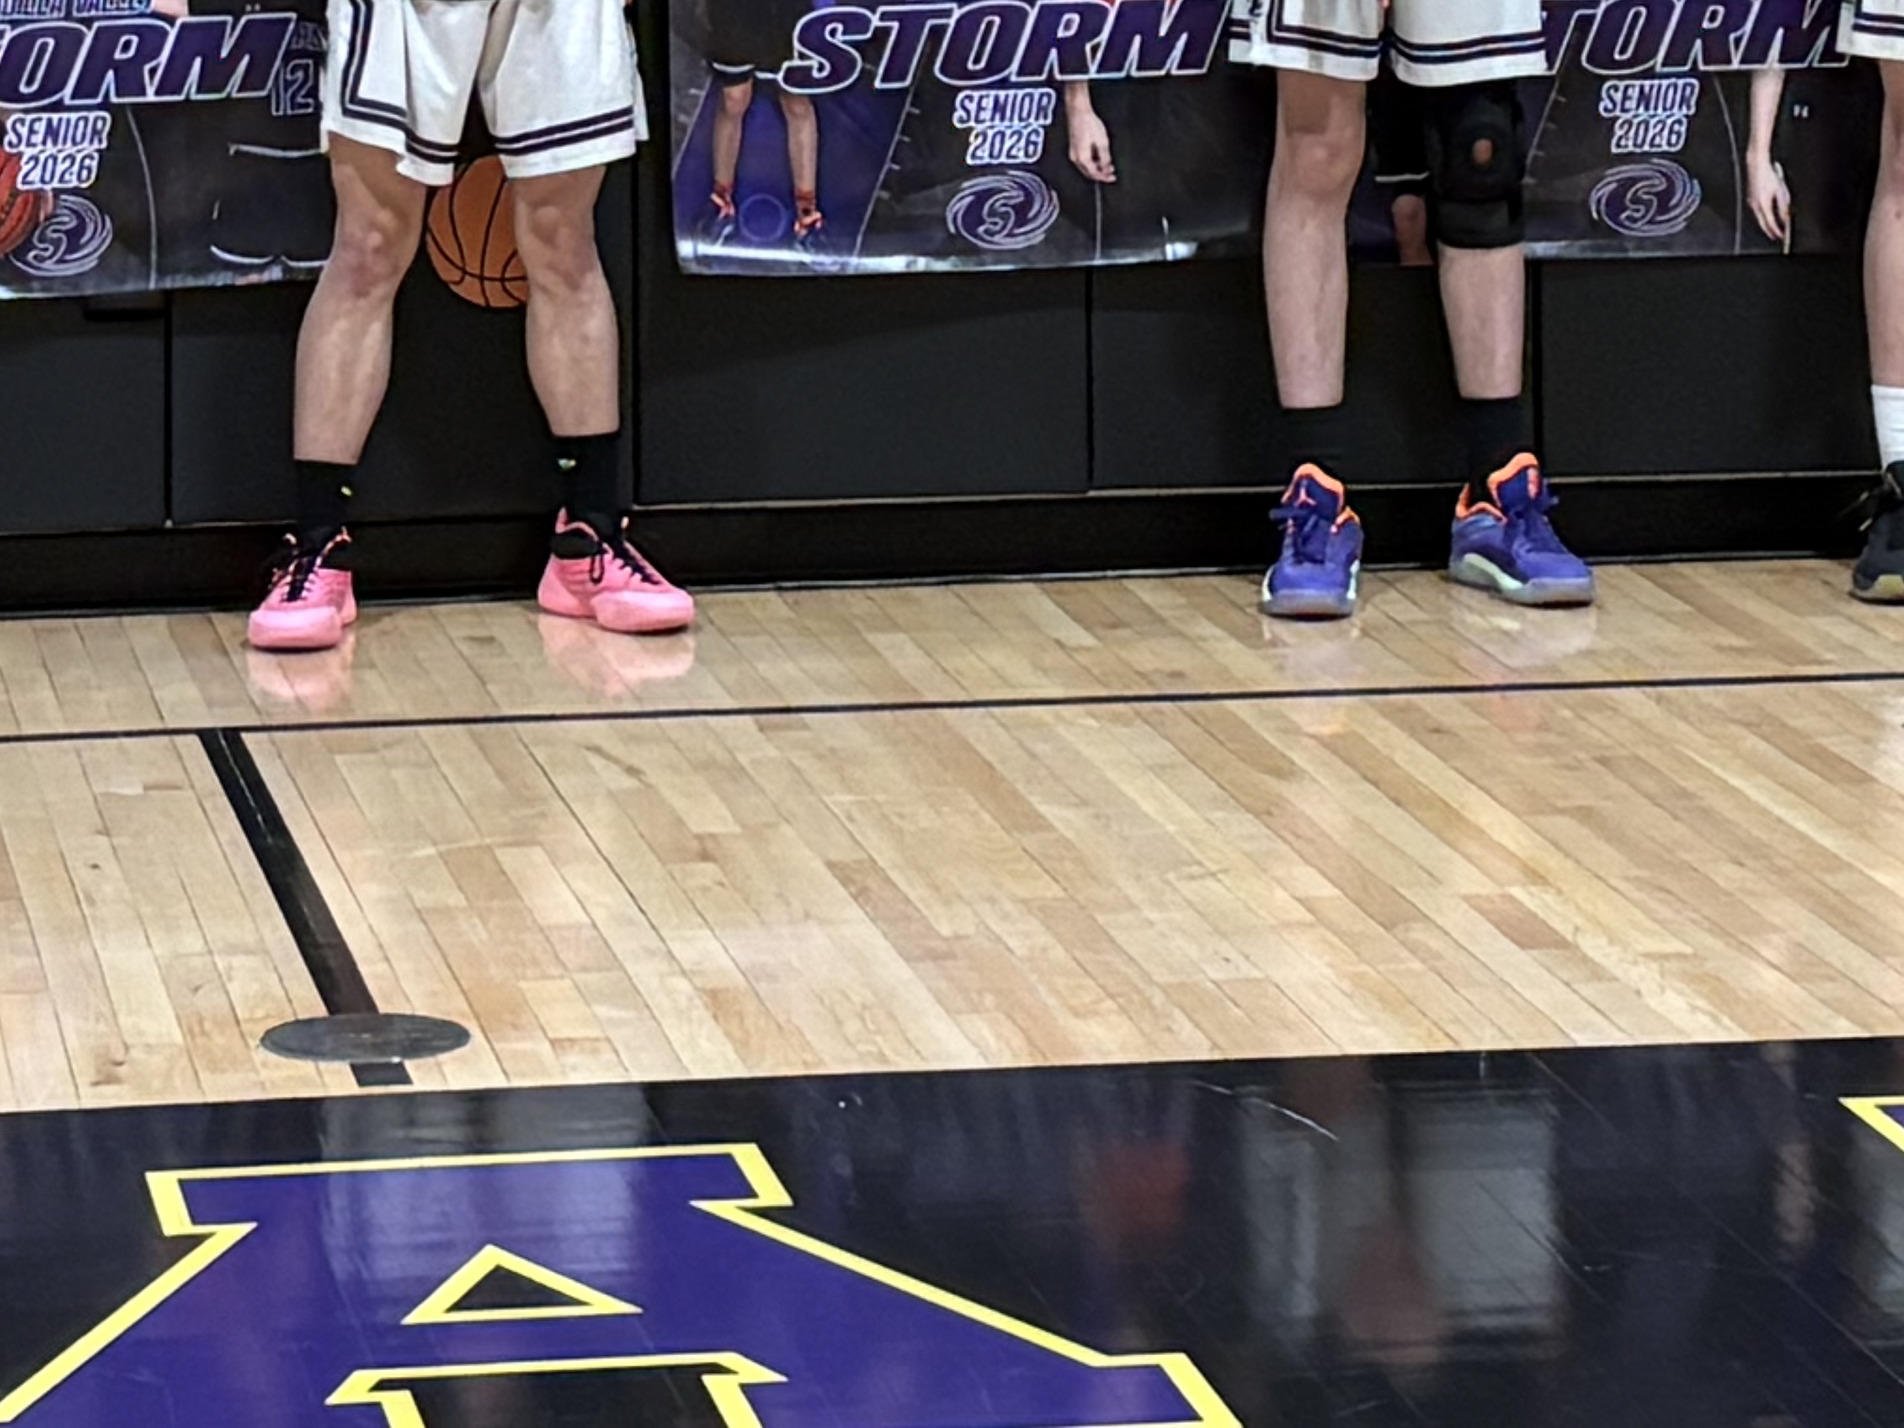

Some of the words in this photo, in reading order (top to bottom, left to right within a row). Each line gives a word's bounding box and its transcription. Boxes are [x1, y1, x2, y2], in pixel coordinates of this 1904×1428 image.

[953, 87, 1053, 129] SENIOR
[1599, 78, 1700, 118] SENIOR
[4, 110, 111, 153] SENIOR
[965, 124, 1044, 166] 2026
[1612, 115, 1687, 153] 2026
[16, 151, 100, 191] 2026
